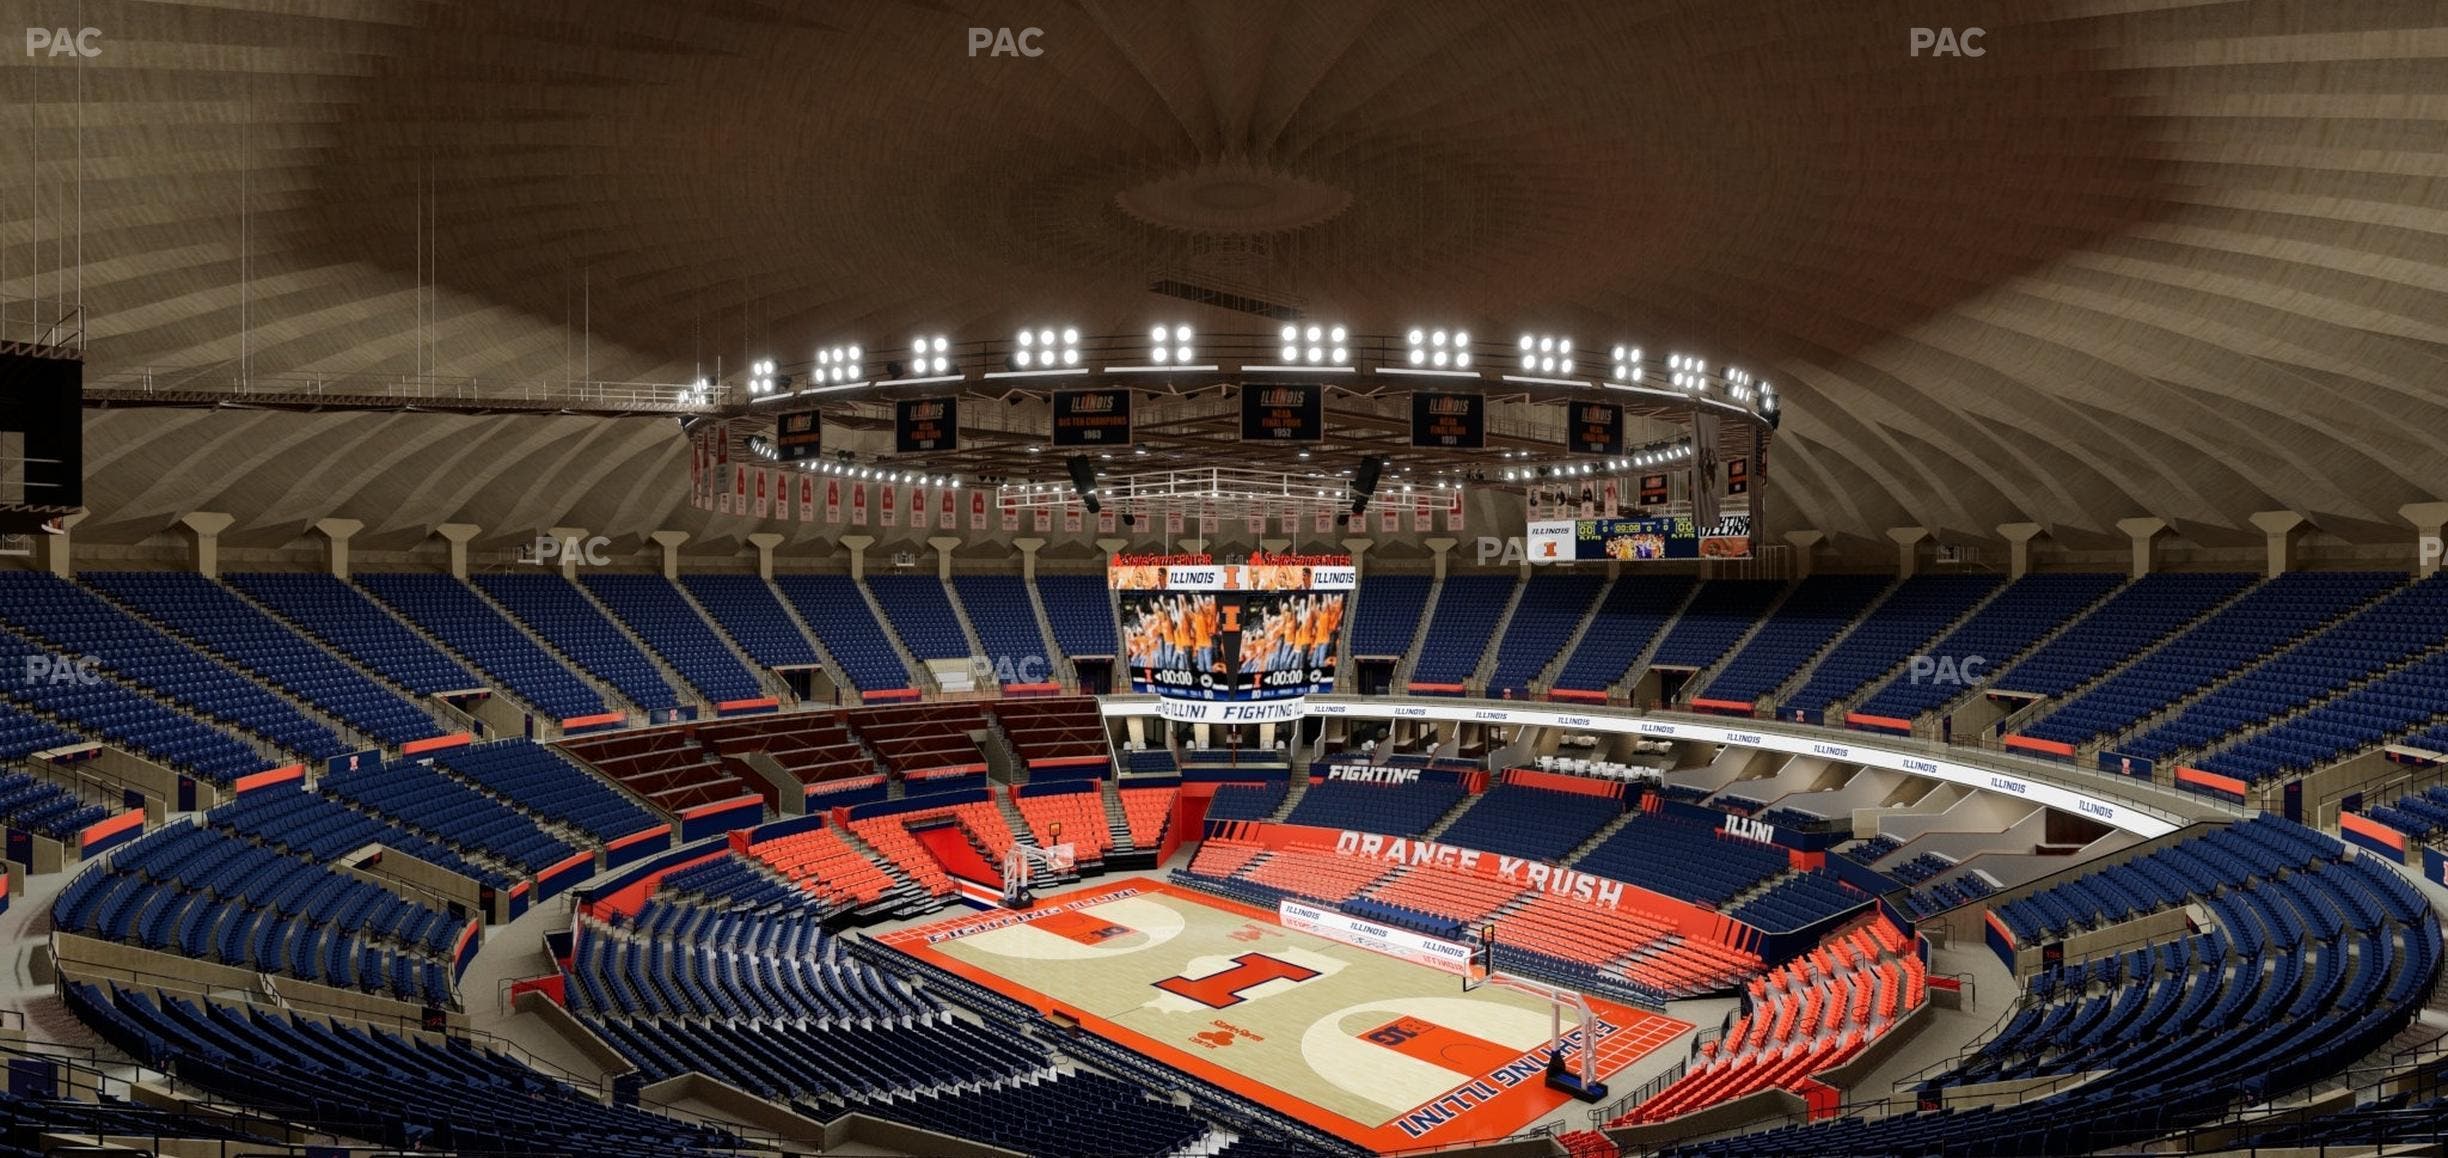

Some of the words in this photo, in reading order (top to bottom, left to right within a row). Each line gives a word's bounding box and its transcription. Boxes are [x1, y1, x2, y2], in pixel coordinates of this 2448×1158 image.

[1071, 394, 1114, 410] ILLINOIS
[1260, 389, 1305, 406] ILLINOIS
[1429, 397, 1469, 413] ILLINOIS
[1170, 572, 1215, 584] ILLINOIS
[1314, 572, 1354, 584] ILLINOIS
[1162, 669, 1192, 686] 00:00
[1272, 669, 1303, 686] 00:00
[1224, 704, 1292, 720] FIGHTING
[1314, 705, 1346, 713] ILLINOIS
[1394, 708, 1426, 716] ILLINOIS
[1476, 711, 1508, 720] ILLINOIS
[1557, 716, 1590, 726] ILLINOIS
[1641, 724, 1676, 734] ILLINOIS
[1726, 732, 1761, 744] ILLINOIS
[1814, 744, 1849, 757] ILLINOIS
[1328, 764, 1421, 784] FIGHTING
[1902, 758, 1937, 774] ILLINOIS
[1990, 777, 2026, 794] ILLINOIS
[2078, 800, 2114, 819] ILLINOIS
[1725, 814, 1774, 844] ILLINI
[1336, 830, 1481, 869] ORANGE
[1497, 855, 1625, 910] KRUSH
[1286, 905, 1320, 920] ILLINOIS
[1350, 922, 1388, 938] ILLINOIS
[1422, 940, 1465, 958] ILLINOIS
[1394, 1079, 1500, 1139] ILLINI
